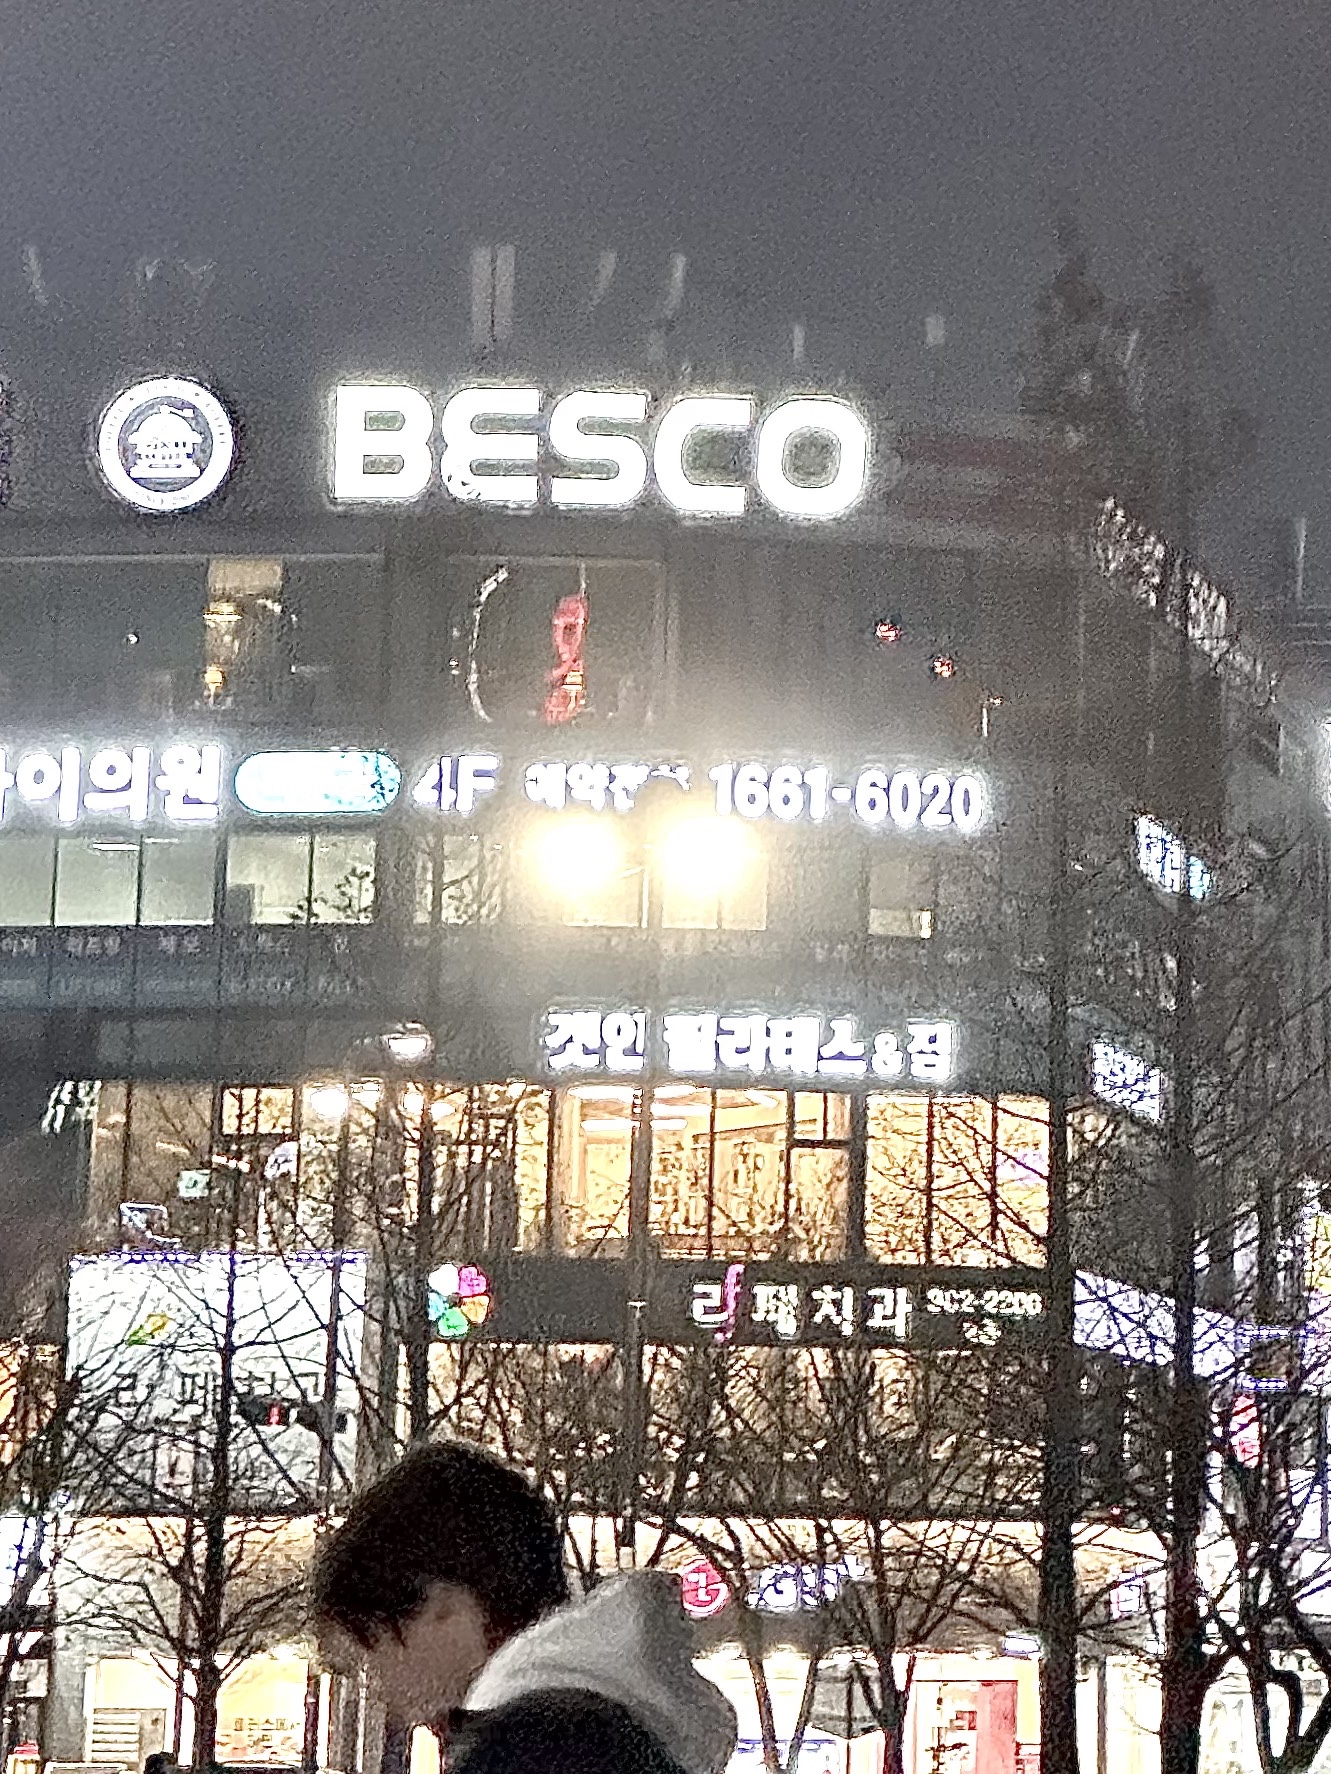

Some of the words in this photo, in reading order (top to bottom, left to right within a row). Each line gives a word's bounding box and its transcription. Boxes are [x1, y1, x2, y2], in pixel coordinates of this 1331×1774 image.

[333, 384, 867, 517] BESCO
[413, 754, 498, 815] 4F
[708, 761, 984, 833] 1661-6020
